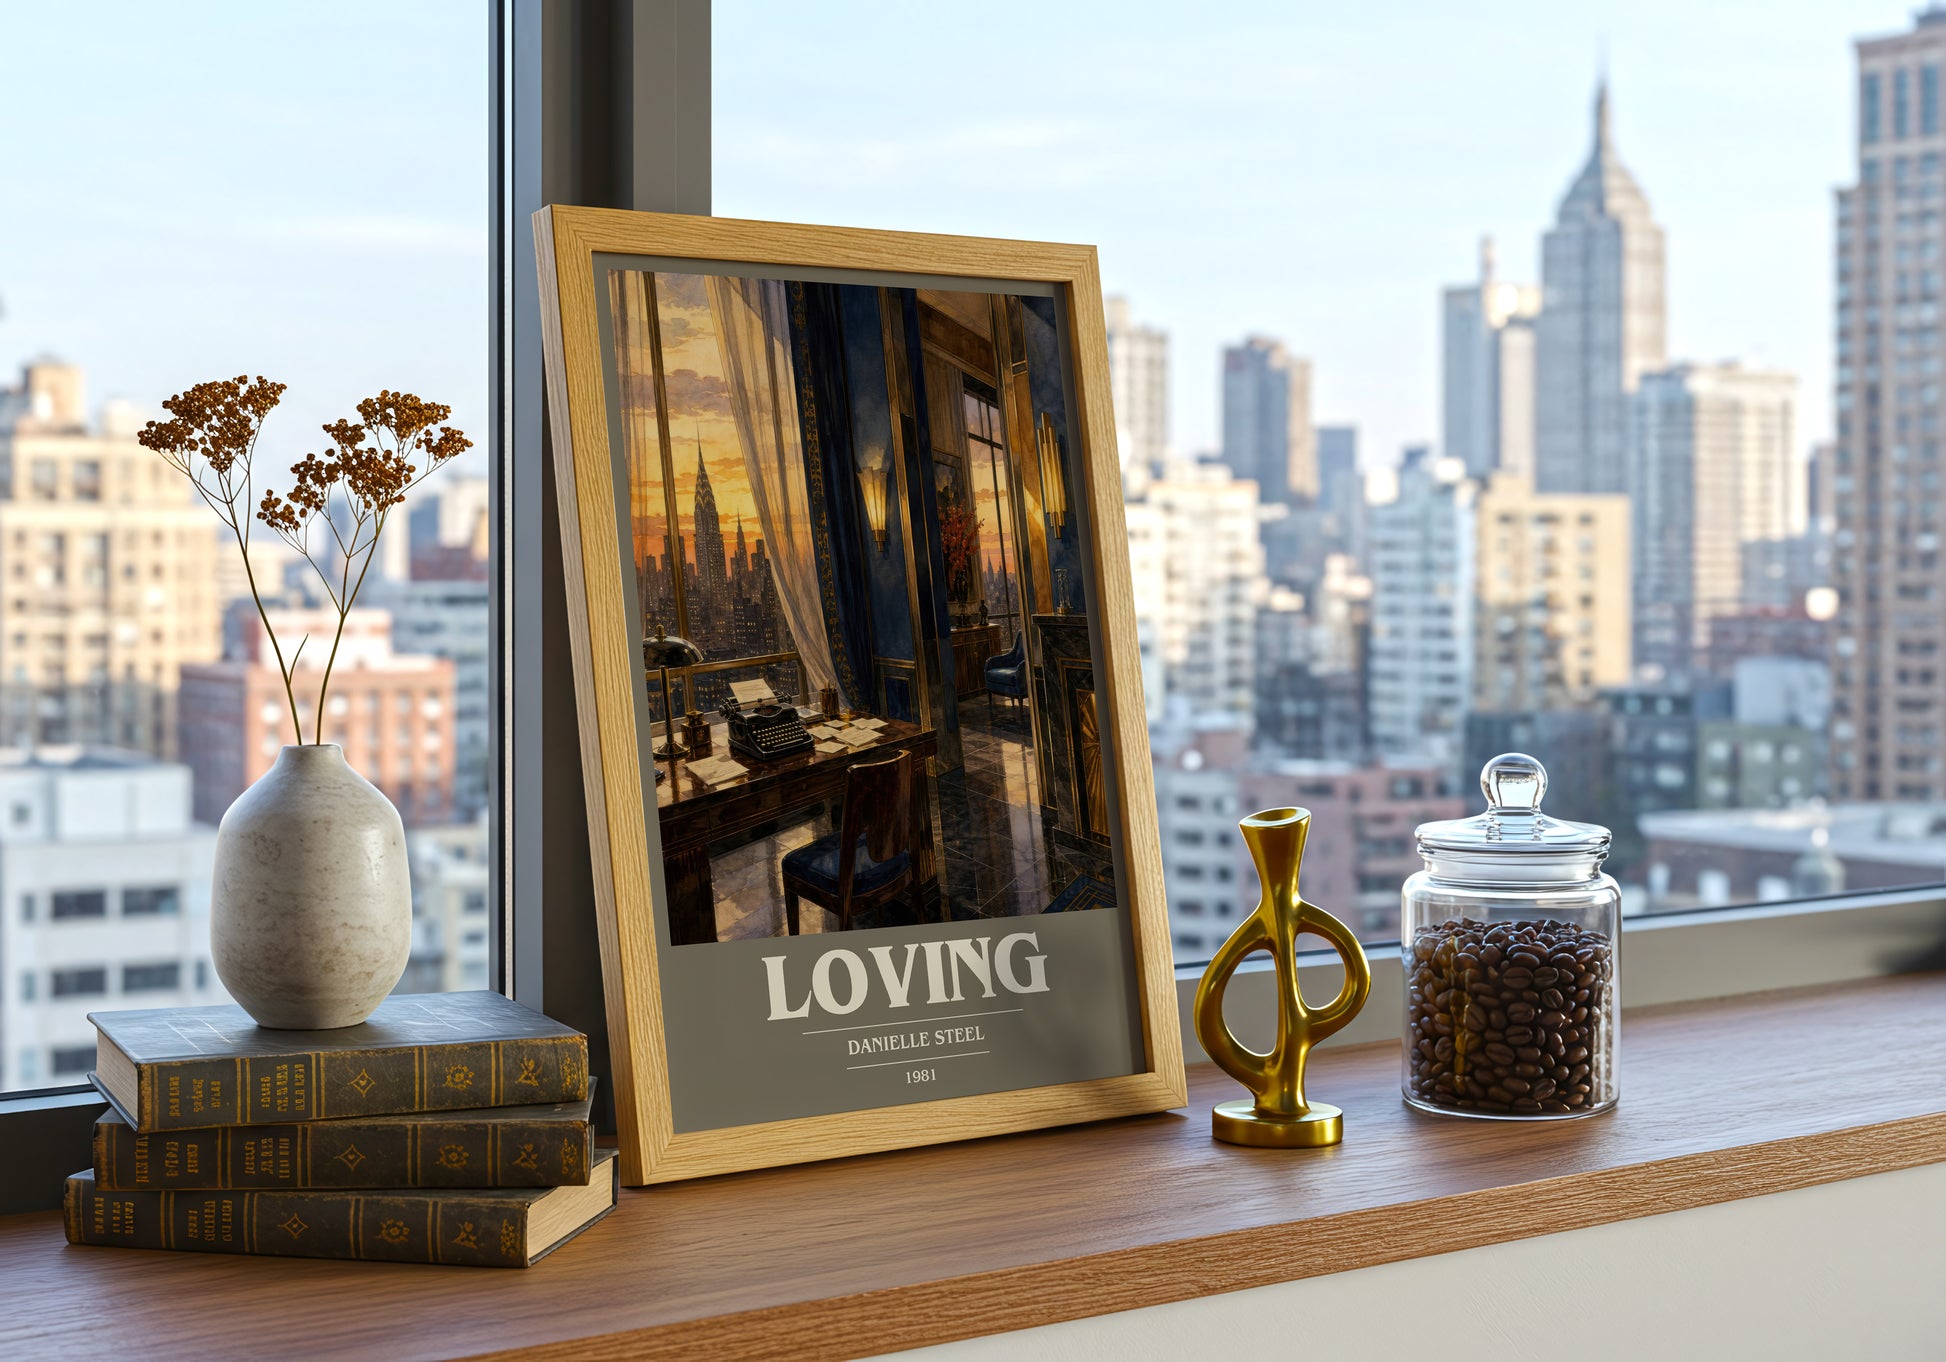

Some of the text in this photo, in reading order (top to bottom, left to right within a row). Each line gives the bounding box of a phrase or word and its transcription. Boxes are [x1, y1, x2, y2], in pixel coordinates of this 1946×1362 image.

[761, 931, 1050, 1021] LOVING
[847, 1025, 986, 1056] DANIELLE STEEL
[905, 1068, 937, 1084] 1981
